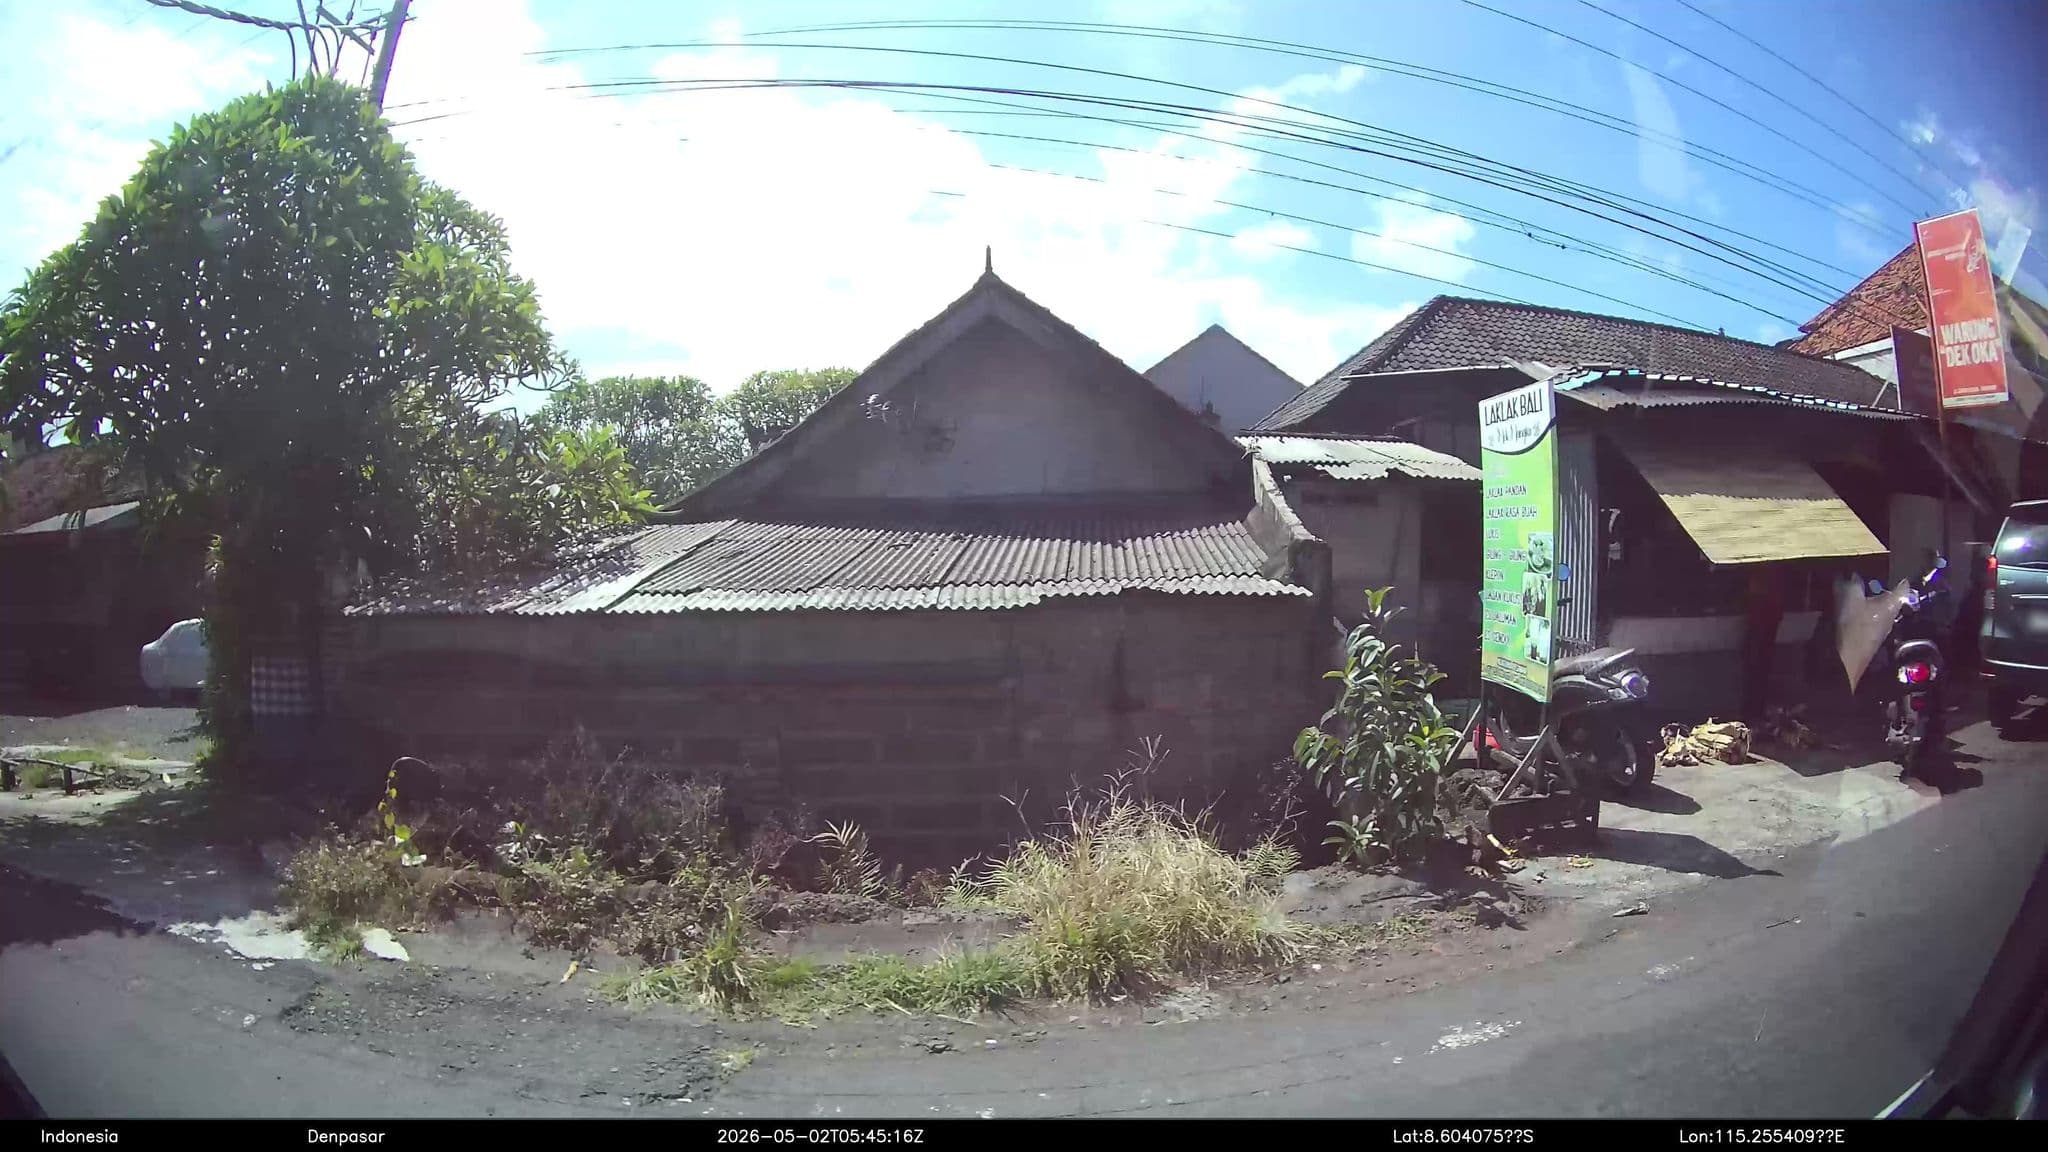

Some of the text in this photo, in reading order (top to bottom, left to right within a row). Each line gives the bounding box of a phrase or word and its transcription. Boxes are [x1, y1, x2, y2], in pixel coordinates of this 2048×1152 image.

[1940, 317, 1997, 345] WARUNG
[1484, 388, 1543, 426] LAKLAK BALI
